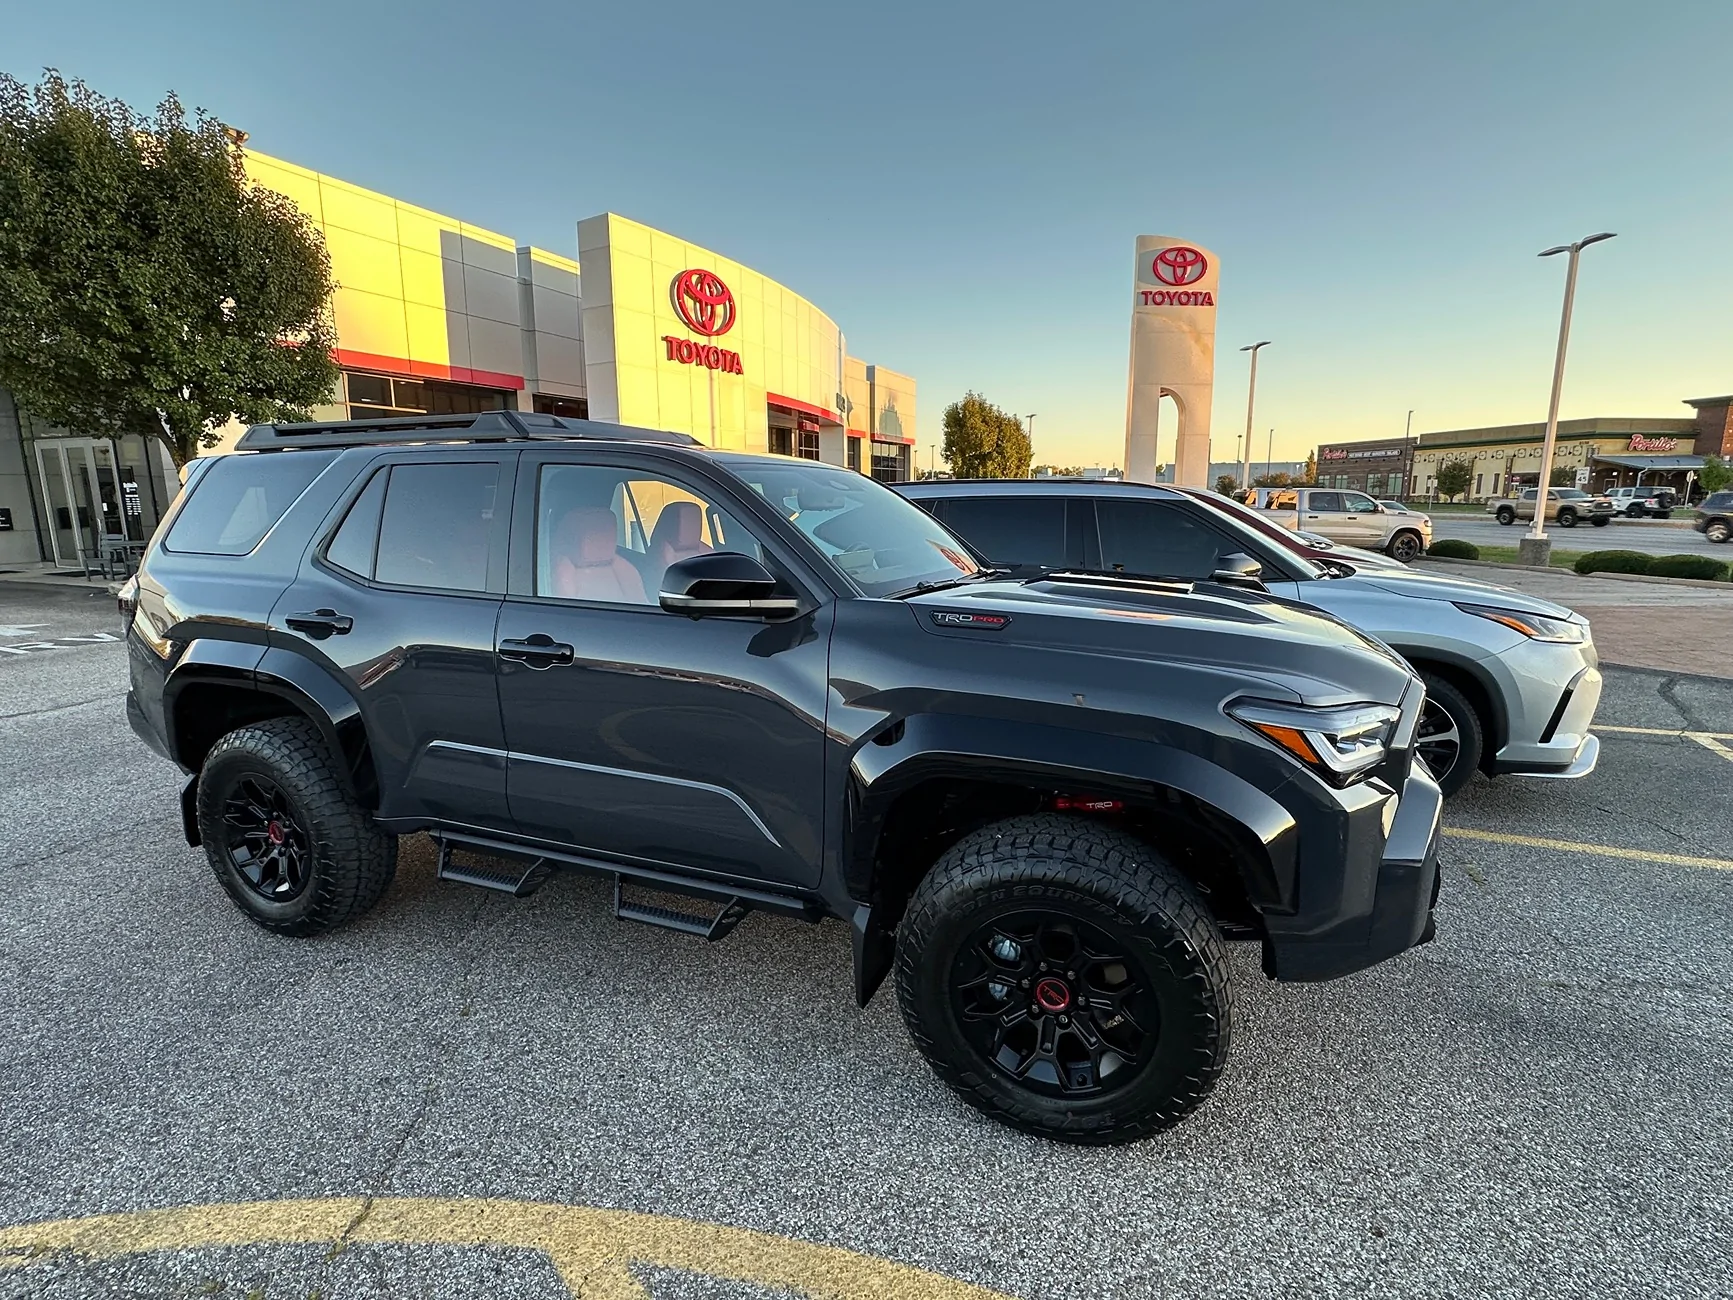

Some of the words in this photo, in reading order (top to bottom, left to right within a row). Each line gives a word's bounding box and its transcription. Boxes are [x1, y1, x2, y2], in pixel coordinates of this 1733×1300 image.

[1141, 290, 1214, 306] TOYOTA
[664, 335, 743, 375] TOYOTA
[1627, 433, 1677, 452] Portillo's
[933, 612, 973, 623] TRD
[973, 615, 1004, 624] PRO
[1086, 801, 1113, 809] TRD
[1043, 985, 1065, 1004] TRD
